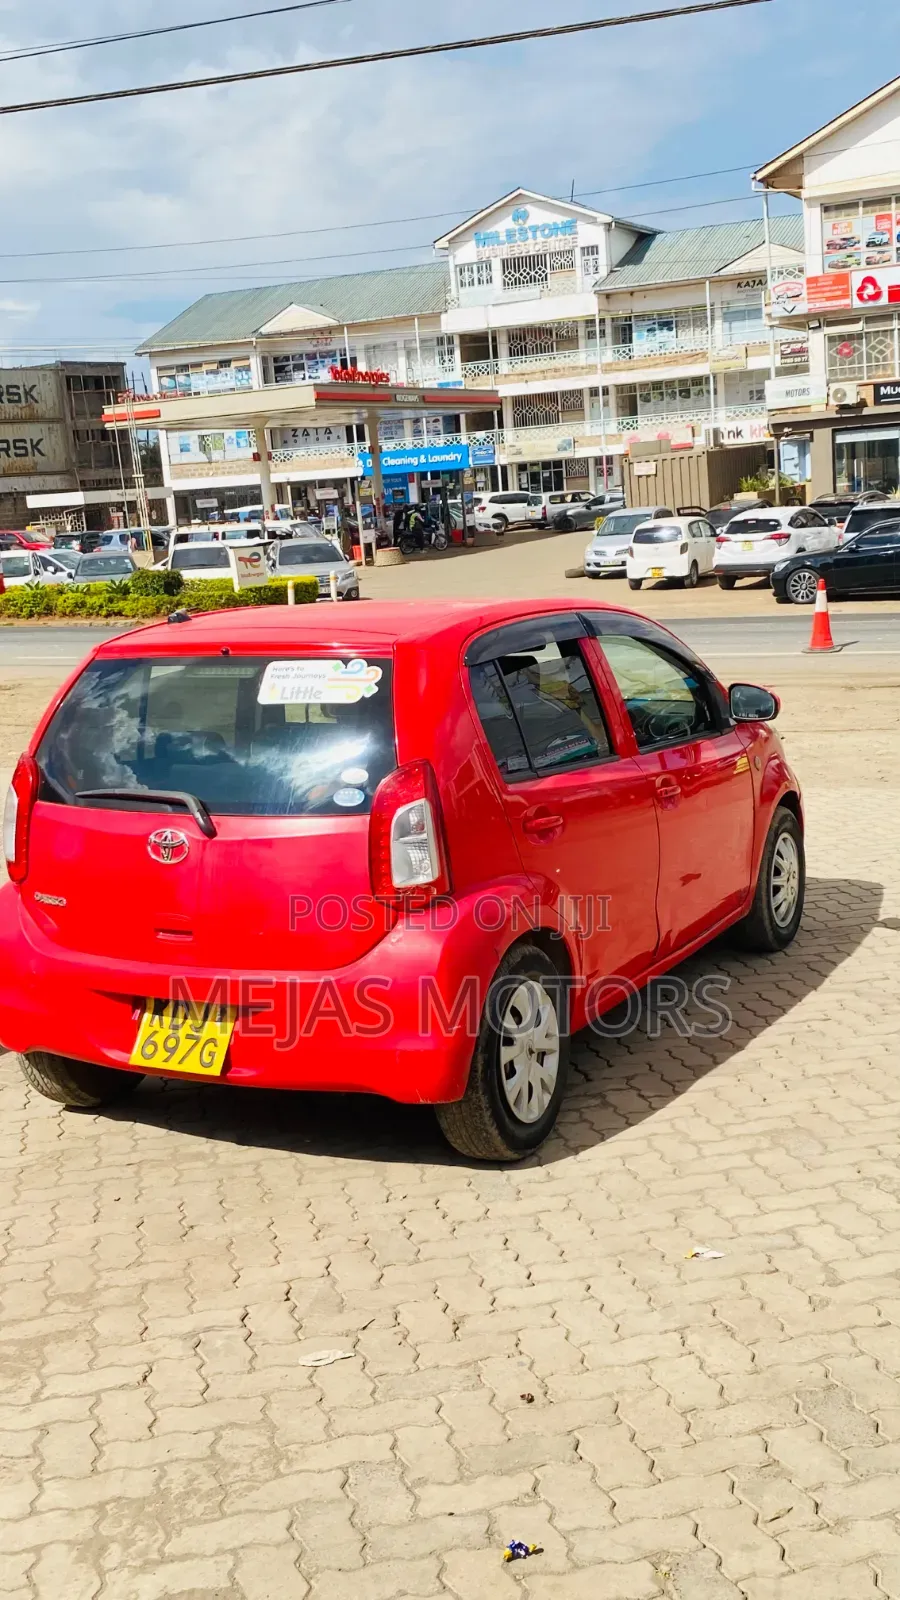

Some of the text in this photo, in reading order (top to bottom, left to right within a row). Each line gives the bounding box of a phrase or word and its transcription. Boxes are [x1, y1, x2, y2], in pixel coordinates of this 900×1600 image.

[473, 218, 578, 249] MILESTONE
[476, 236, 579, 261] BUSINESS CENTRE
[785, 387, 811, 398] MOTORS
[382, 455, 419, 468] Cleaning
[419, 454, 427, 464] &
[428, 452, 463, 464] Laundry
[280, 685, 323, 701] Little
[140, 1030, 219, 1069] 697G
